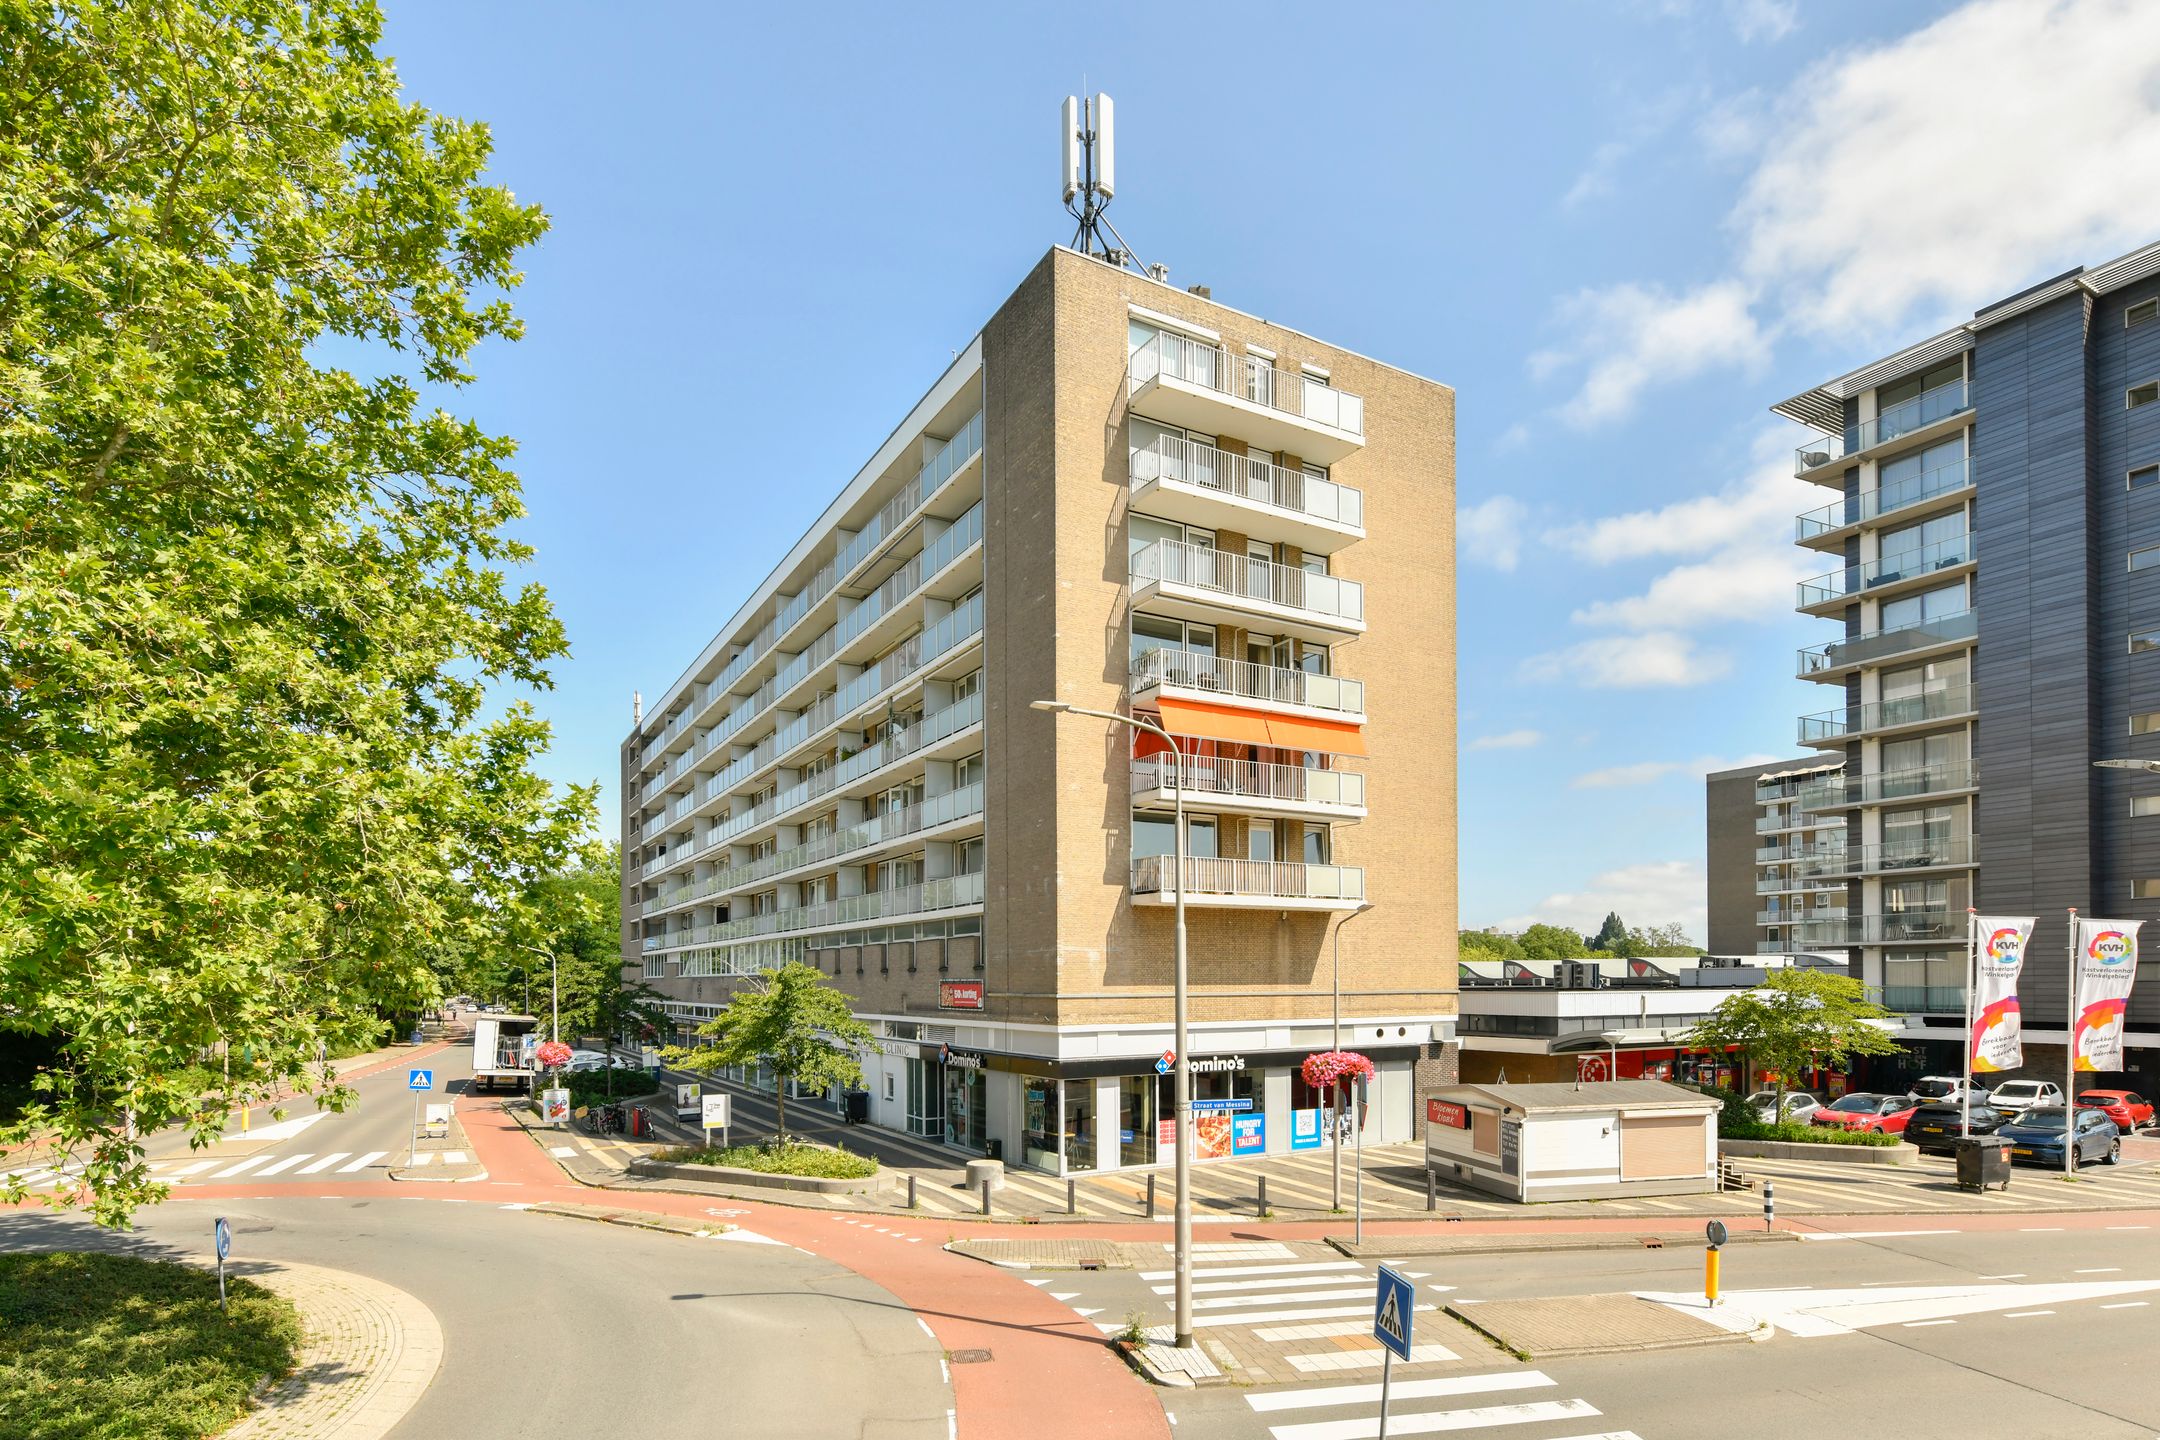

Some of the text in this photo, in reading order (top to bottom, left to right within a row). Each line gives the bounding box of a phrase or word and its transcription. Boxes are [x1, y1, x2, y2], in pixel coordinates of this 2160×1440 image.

[1996, 942, 2019, 950] KVH
[2098, 944, 2124, 952] KVH
[886, 1043, 910, 1056] CLINIC
[948, 1051, 981, 1068] Domino's
[1432, 1101, 1459, 1116] Bloemen
[1235, 1118, 1262, 1129] HUNGRY
[1242, 1128, 1255, 1137] FOR
[1237, 1137, 1260, 1146] TALENT
